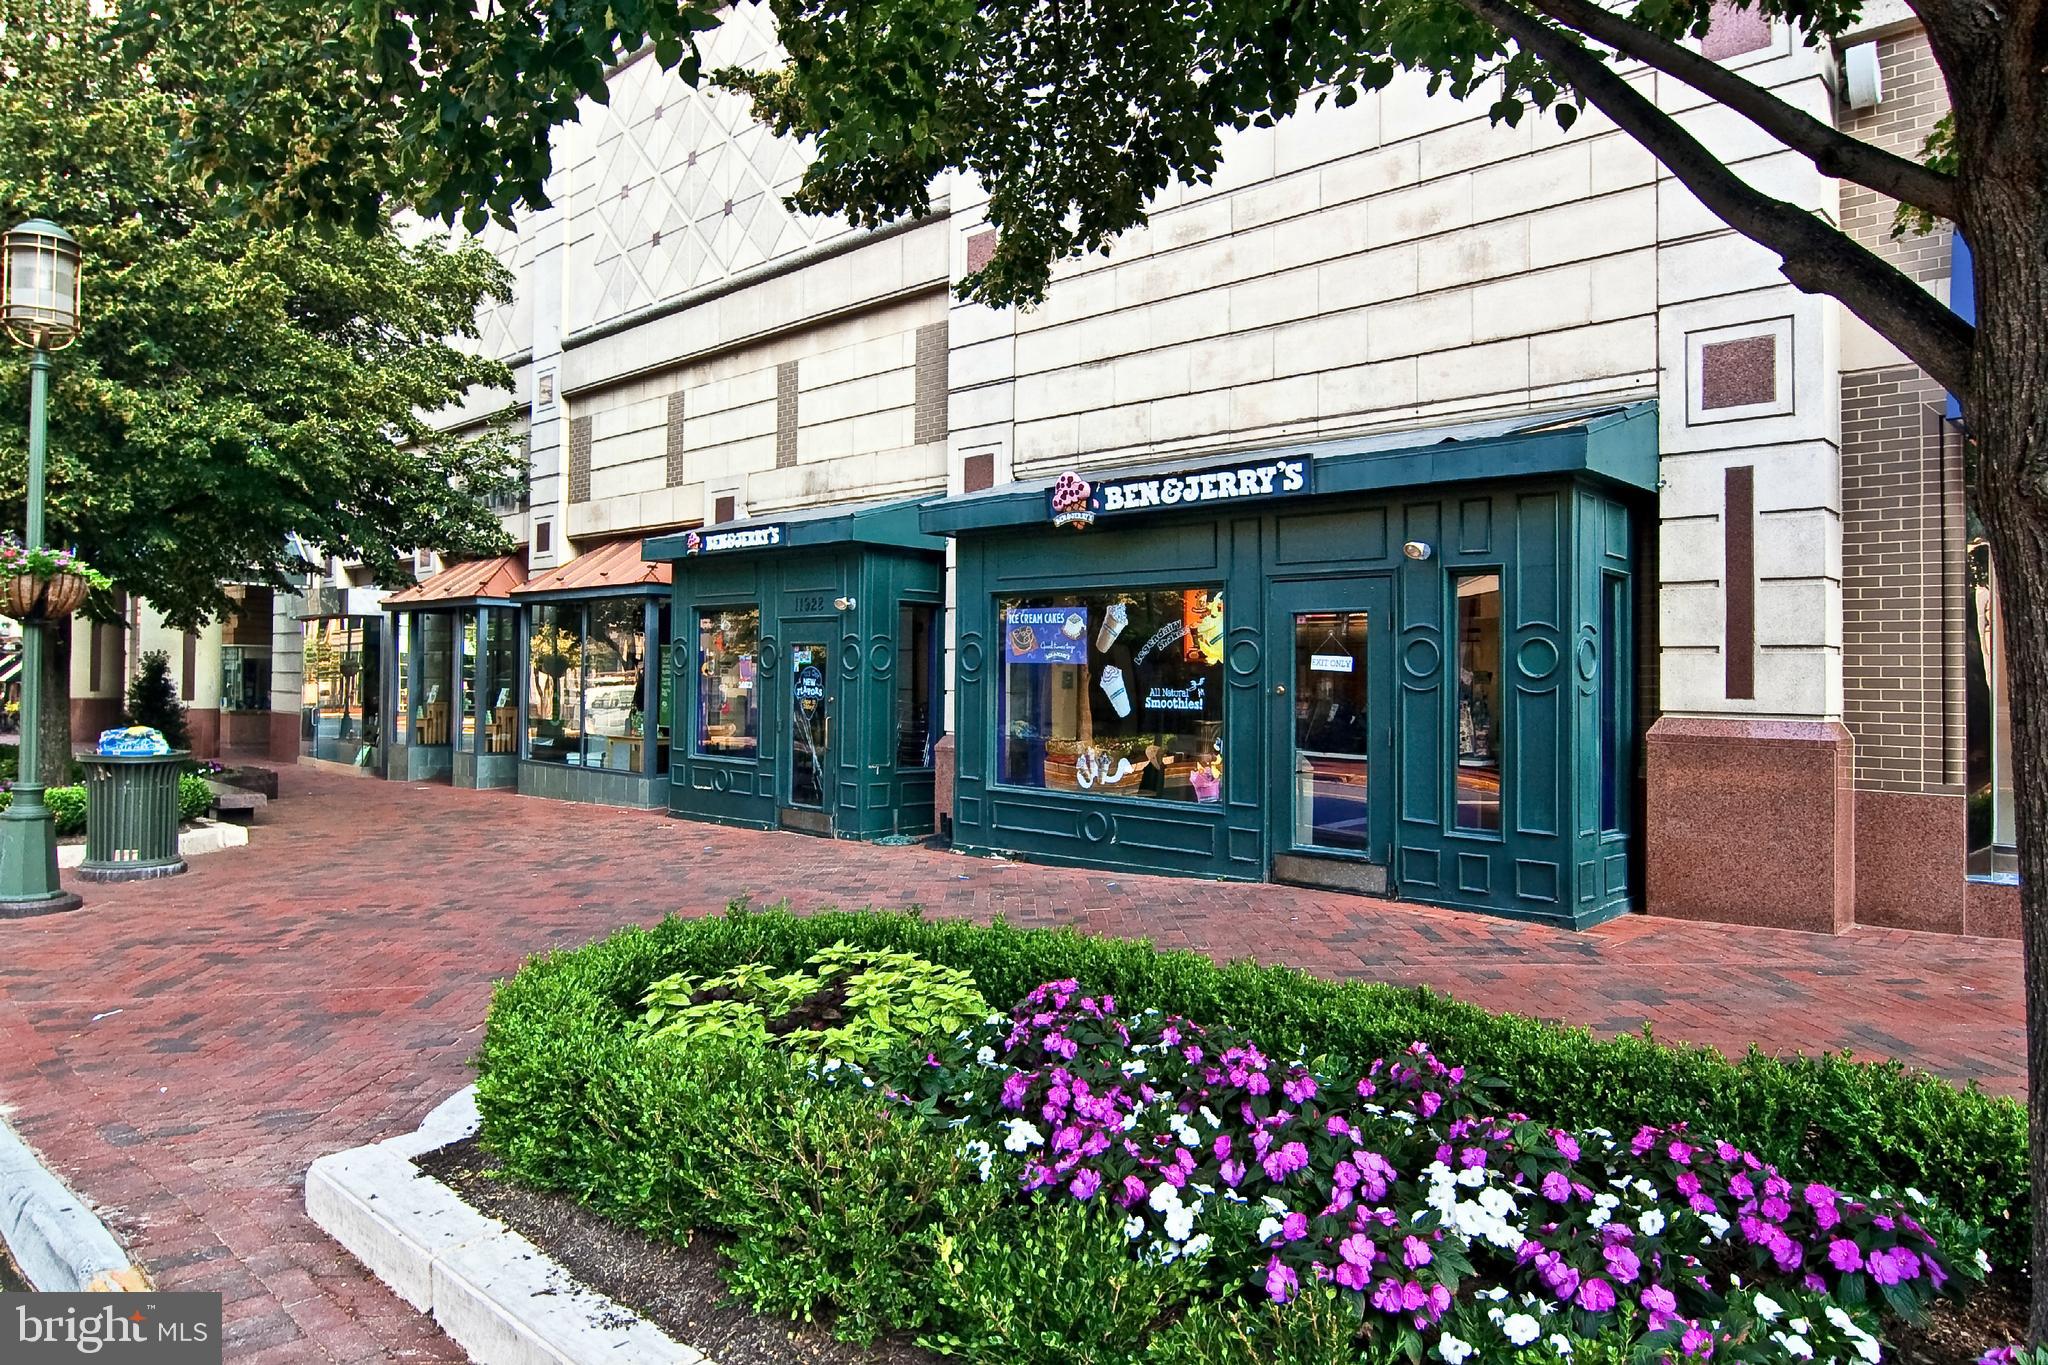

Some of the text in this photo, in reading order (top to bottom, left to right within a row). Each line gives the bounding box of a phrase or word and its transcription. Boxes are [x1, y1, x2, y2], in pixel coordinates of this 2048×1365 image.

[1104, 461, 1304, 511] BEN&JERRY'S
[1008, 612, 1065, 624] ICE CREAM CAKES
[1312, 658, 1352, 668] EXIT ONLY
[803, 678, 817, 687] NEW
[796, 685, 823, 697] FLAVORS
[1149, 687, 1190, 698] All Natural
[1145, 697, 1203, 710] Smoothies!
